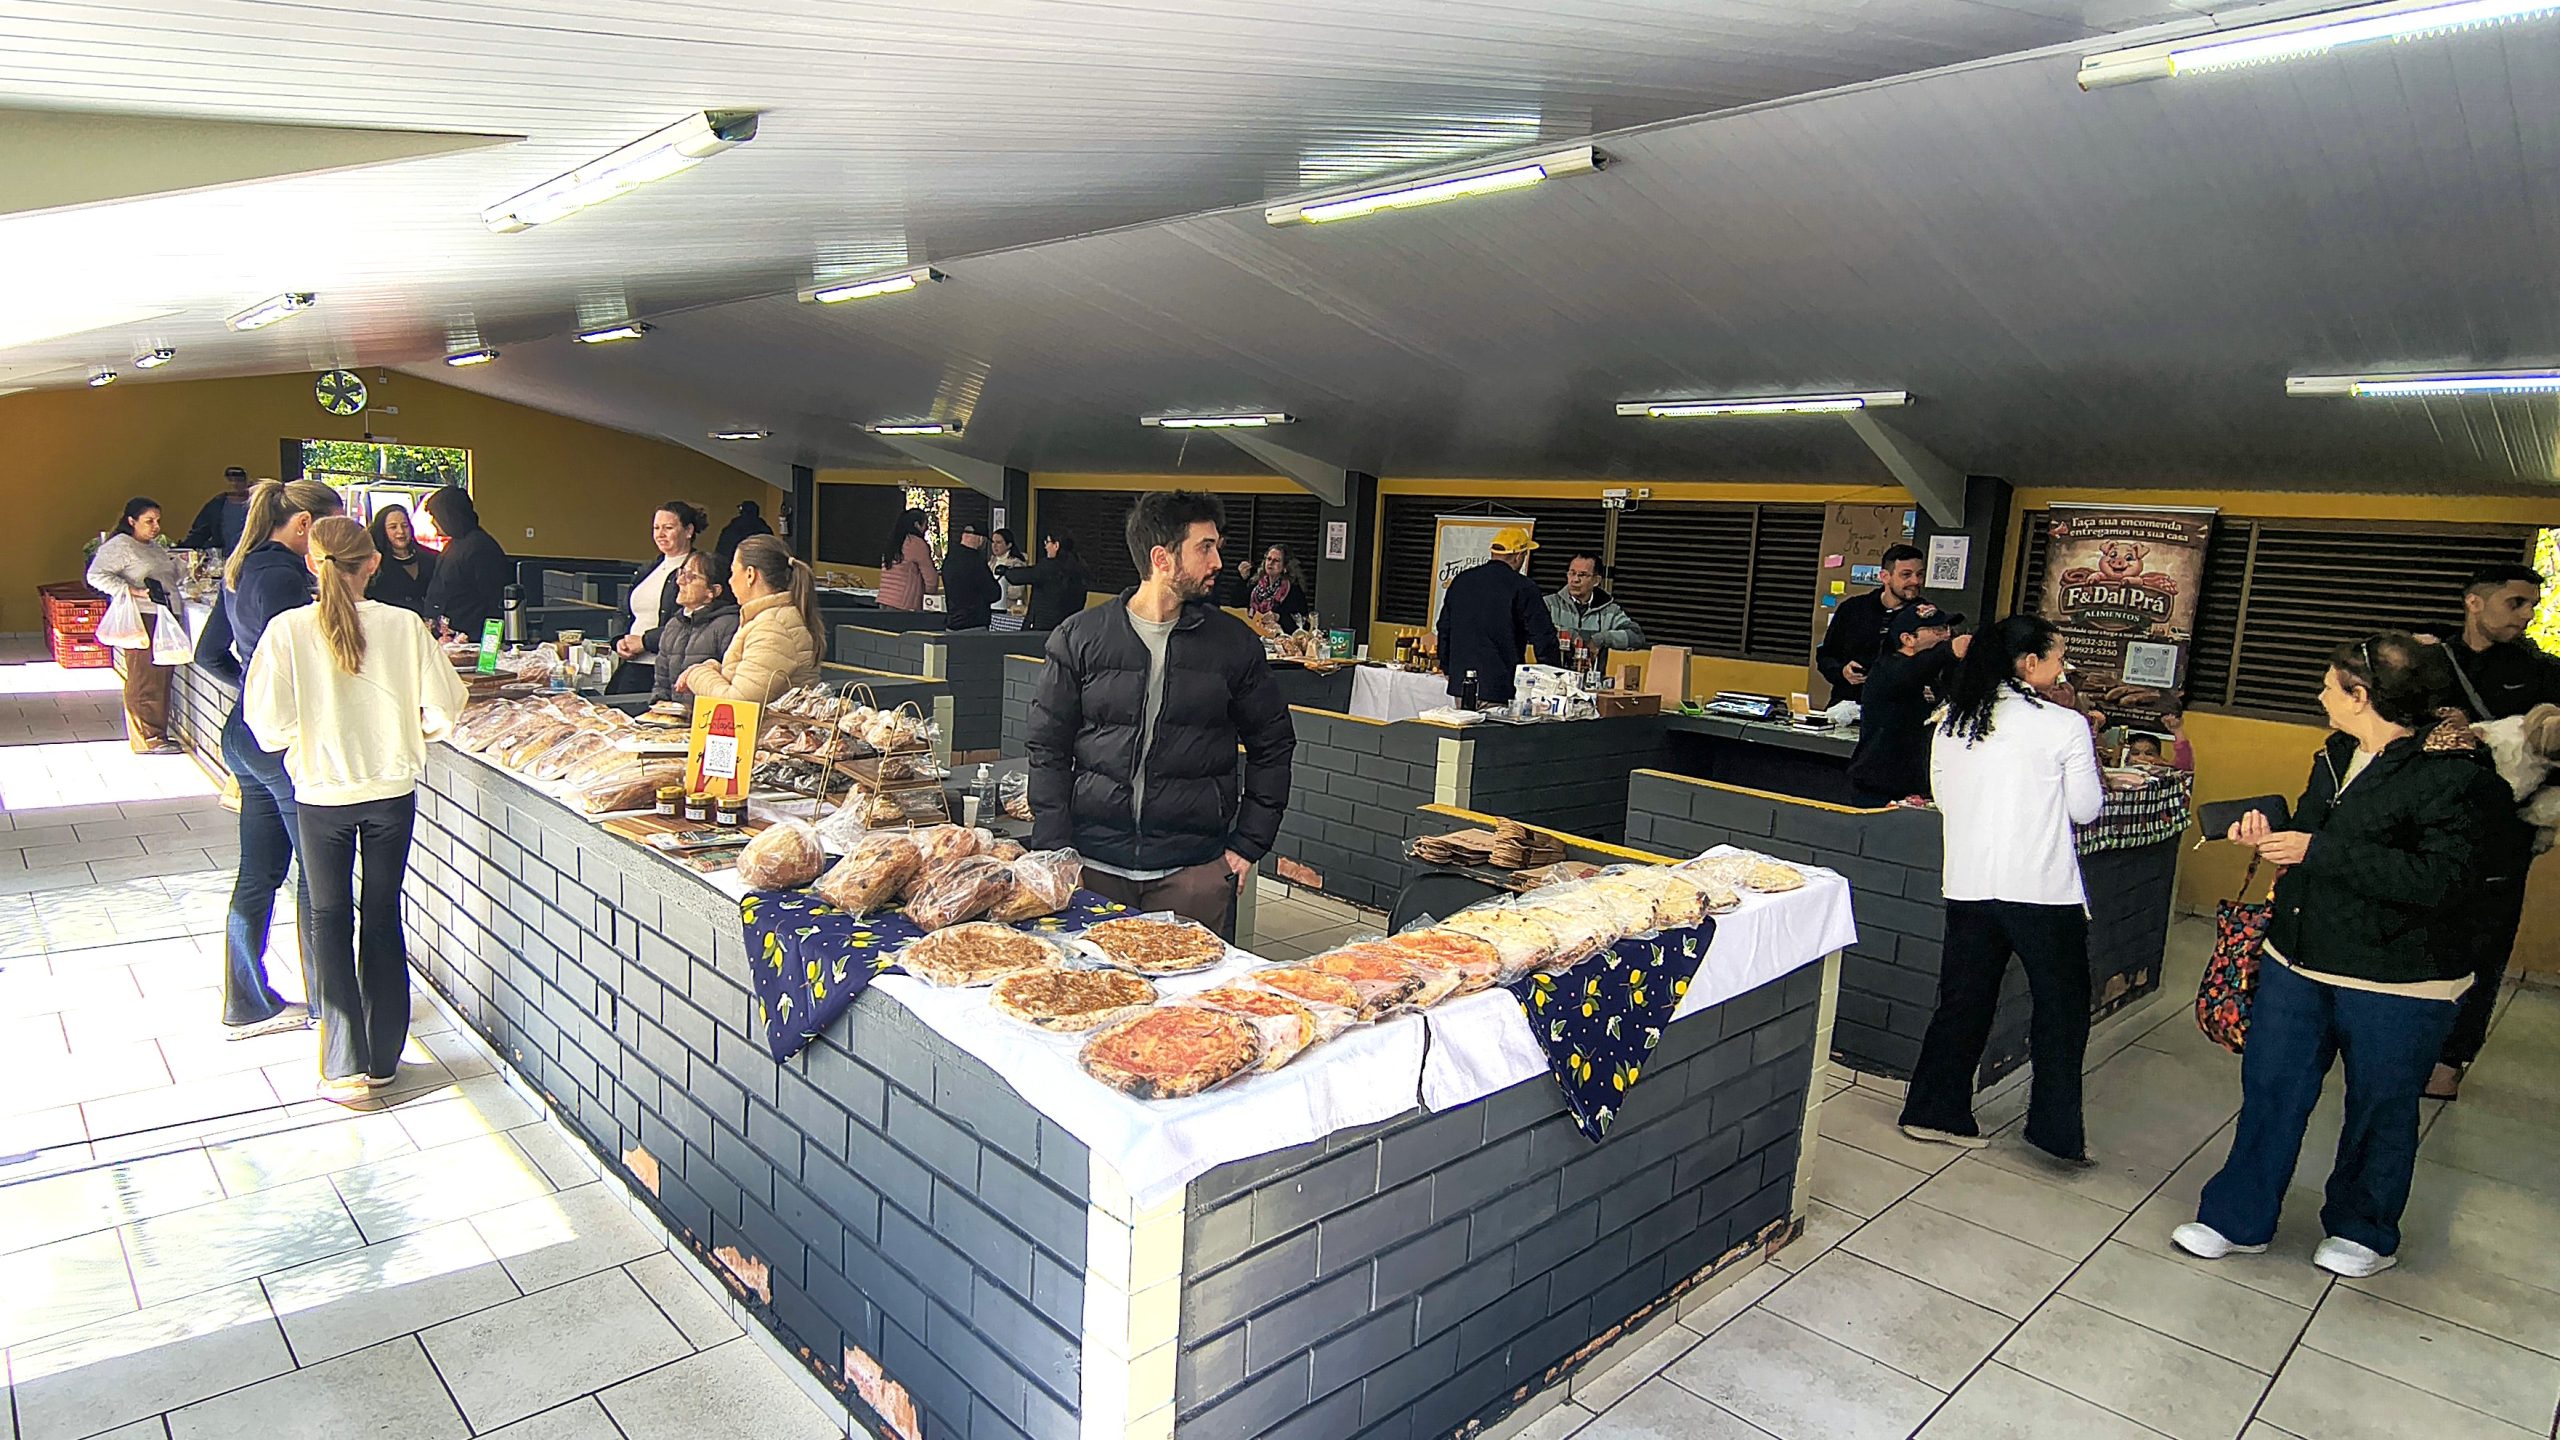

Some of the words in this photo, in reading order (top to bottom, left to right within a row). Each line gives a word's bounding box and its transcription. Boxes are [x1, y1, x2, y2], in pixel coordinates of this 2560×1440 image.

[2072, 517, 2096, 528] Faça
[2098, 518, 2118, 526] sua
[2120, 519, 2182, 531] encomenda
[2070, 528, 2131, 538] entregamos
[2132, 529, 2145, 537] na
[2147, 530, 2165, 538] sua
[2166, 533, 2189, 542] casa
[2129, 588, 2165, 613] Prá
[2084, 610, 2140, 622] ALIMENTOS
